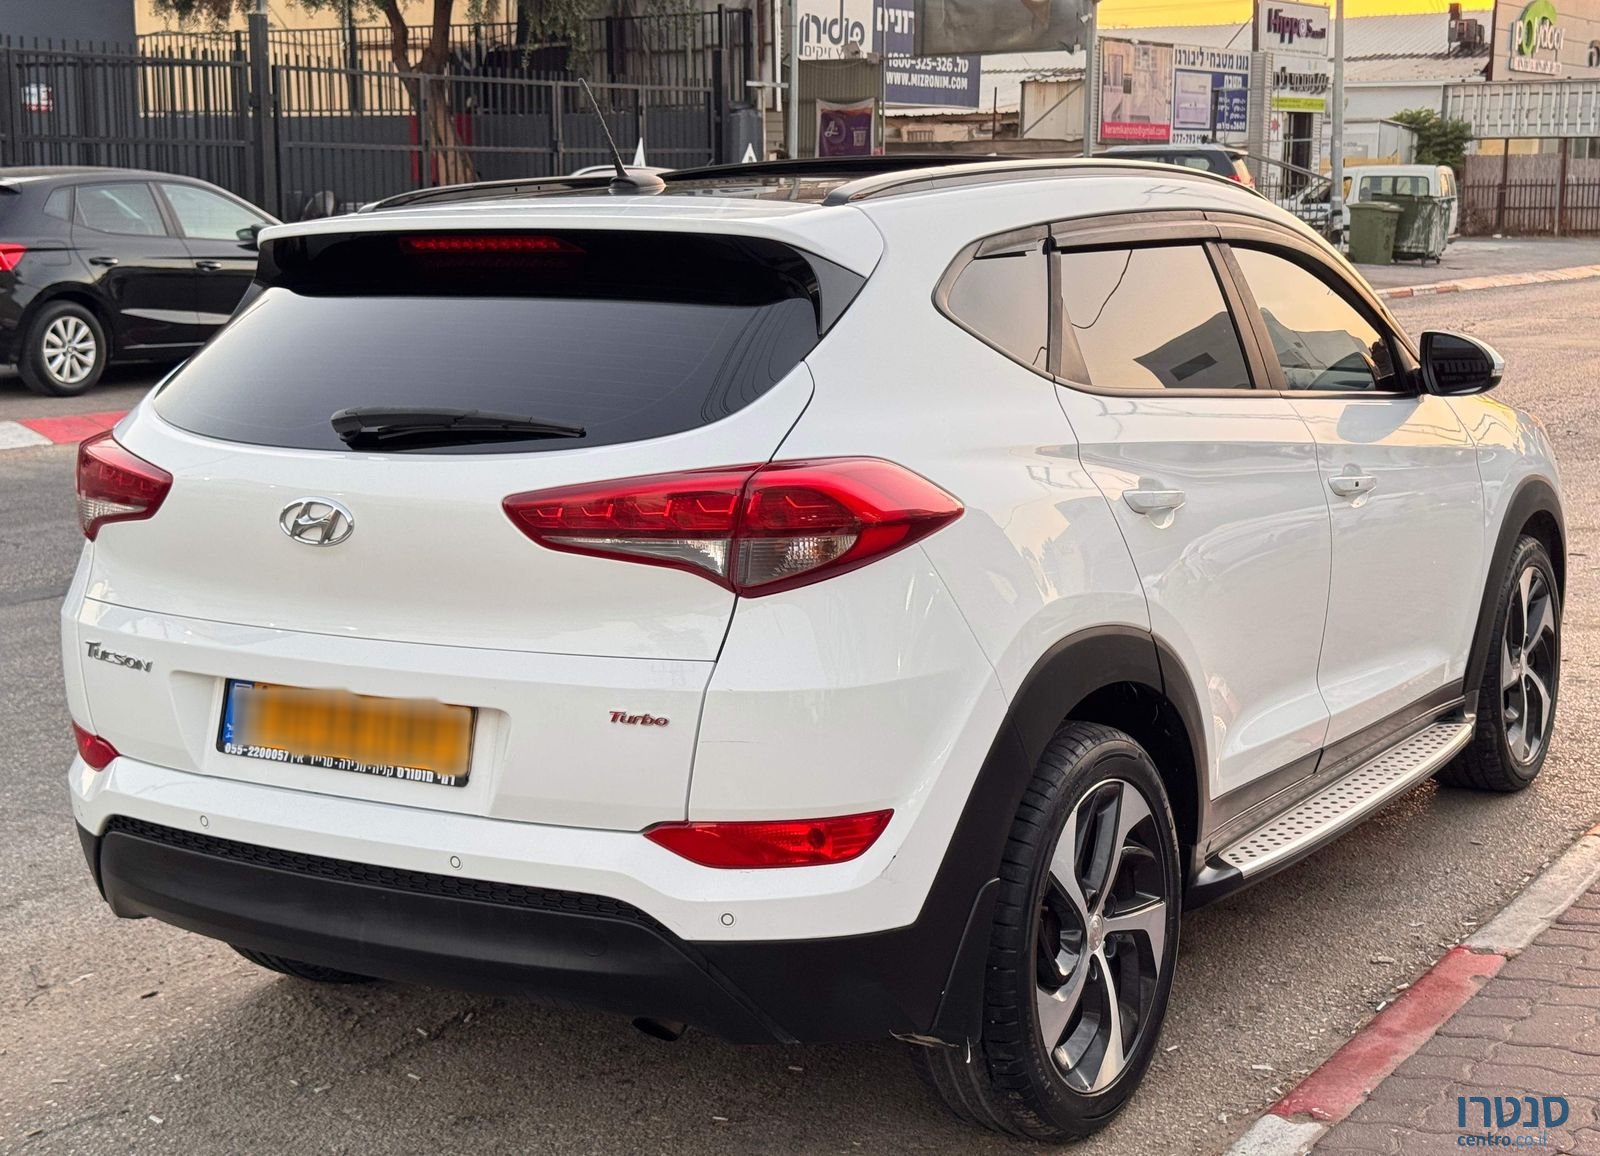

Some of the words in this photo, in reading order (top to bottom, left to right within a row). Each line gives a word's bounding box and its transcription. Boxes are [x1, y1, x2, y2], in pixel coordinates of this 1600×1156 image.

[1174, 46, 1204, 66] ליבורנו
[1206, 51, 1234, 69] מטבחי
[885, 71, 968, 90] WWW.MIZRONIM.COM
[608, 710, 670, 727] Turbo
[224, 742, 289, 762] 055-2200057
[396, 766, 434, 783] מוטורס
